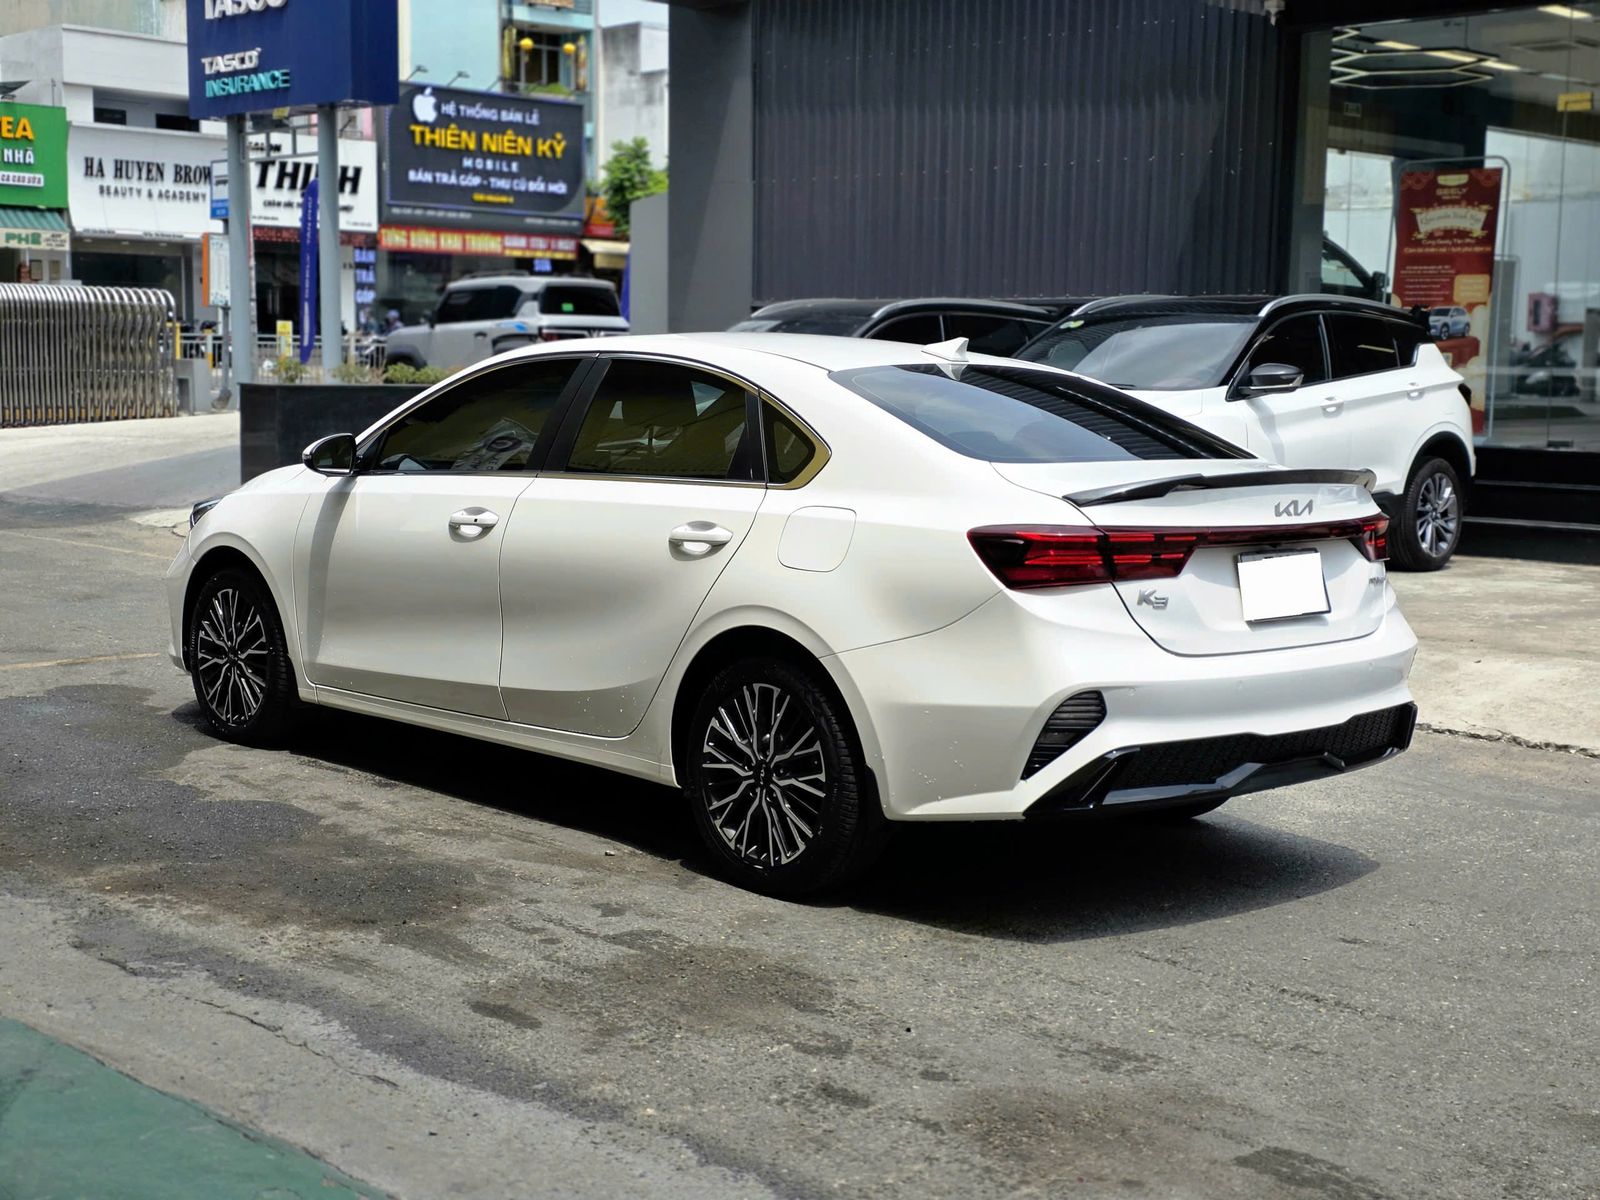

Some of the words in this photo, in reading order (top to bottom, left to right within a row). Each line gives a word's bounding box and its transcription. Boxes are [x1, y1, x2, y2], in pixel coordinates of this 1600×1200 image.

[201, 48, 260, 75] TASCO
[205, 69, 291, 98] INSURANCE
[410, 123, 477, 151] THIÊN
[481, 128, 533, 156] NIÊN
[537, 131, 567, 159] KỶ
[83, 156, 105, 178] HA
[113, 159, 165, 182] HUYEN
[462, 157, 520, 173] MOBILE
[407, 169, 433, 184] BÁN
[434, 171, 457, 187] TRẢ
[458, 173, 482, 189] GÓP
[489, 177, 512, 191] THU
[98, 184, 142, 198] BEAUTY
[147, 188, 153, 199] &
[157, 189, 207, 203] ACADEMY
[1274, 499, 1314, 518] KIA
[1136, 588, 1169, 610] K3
